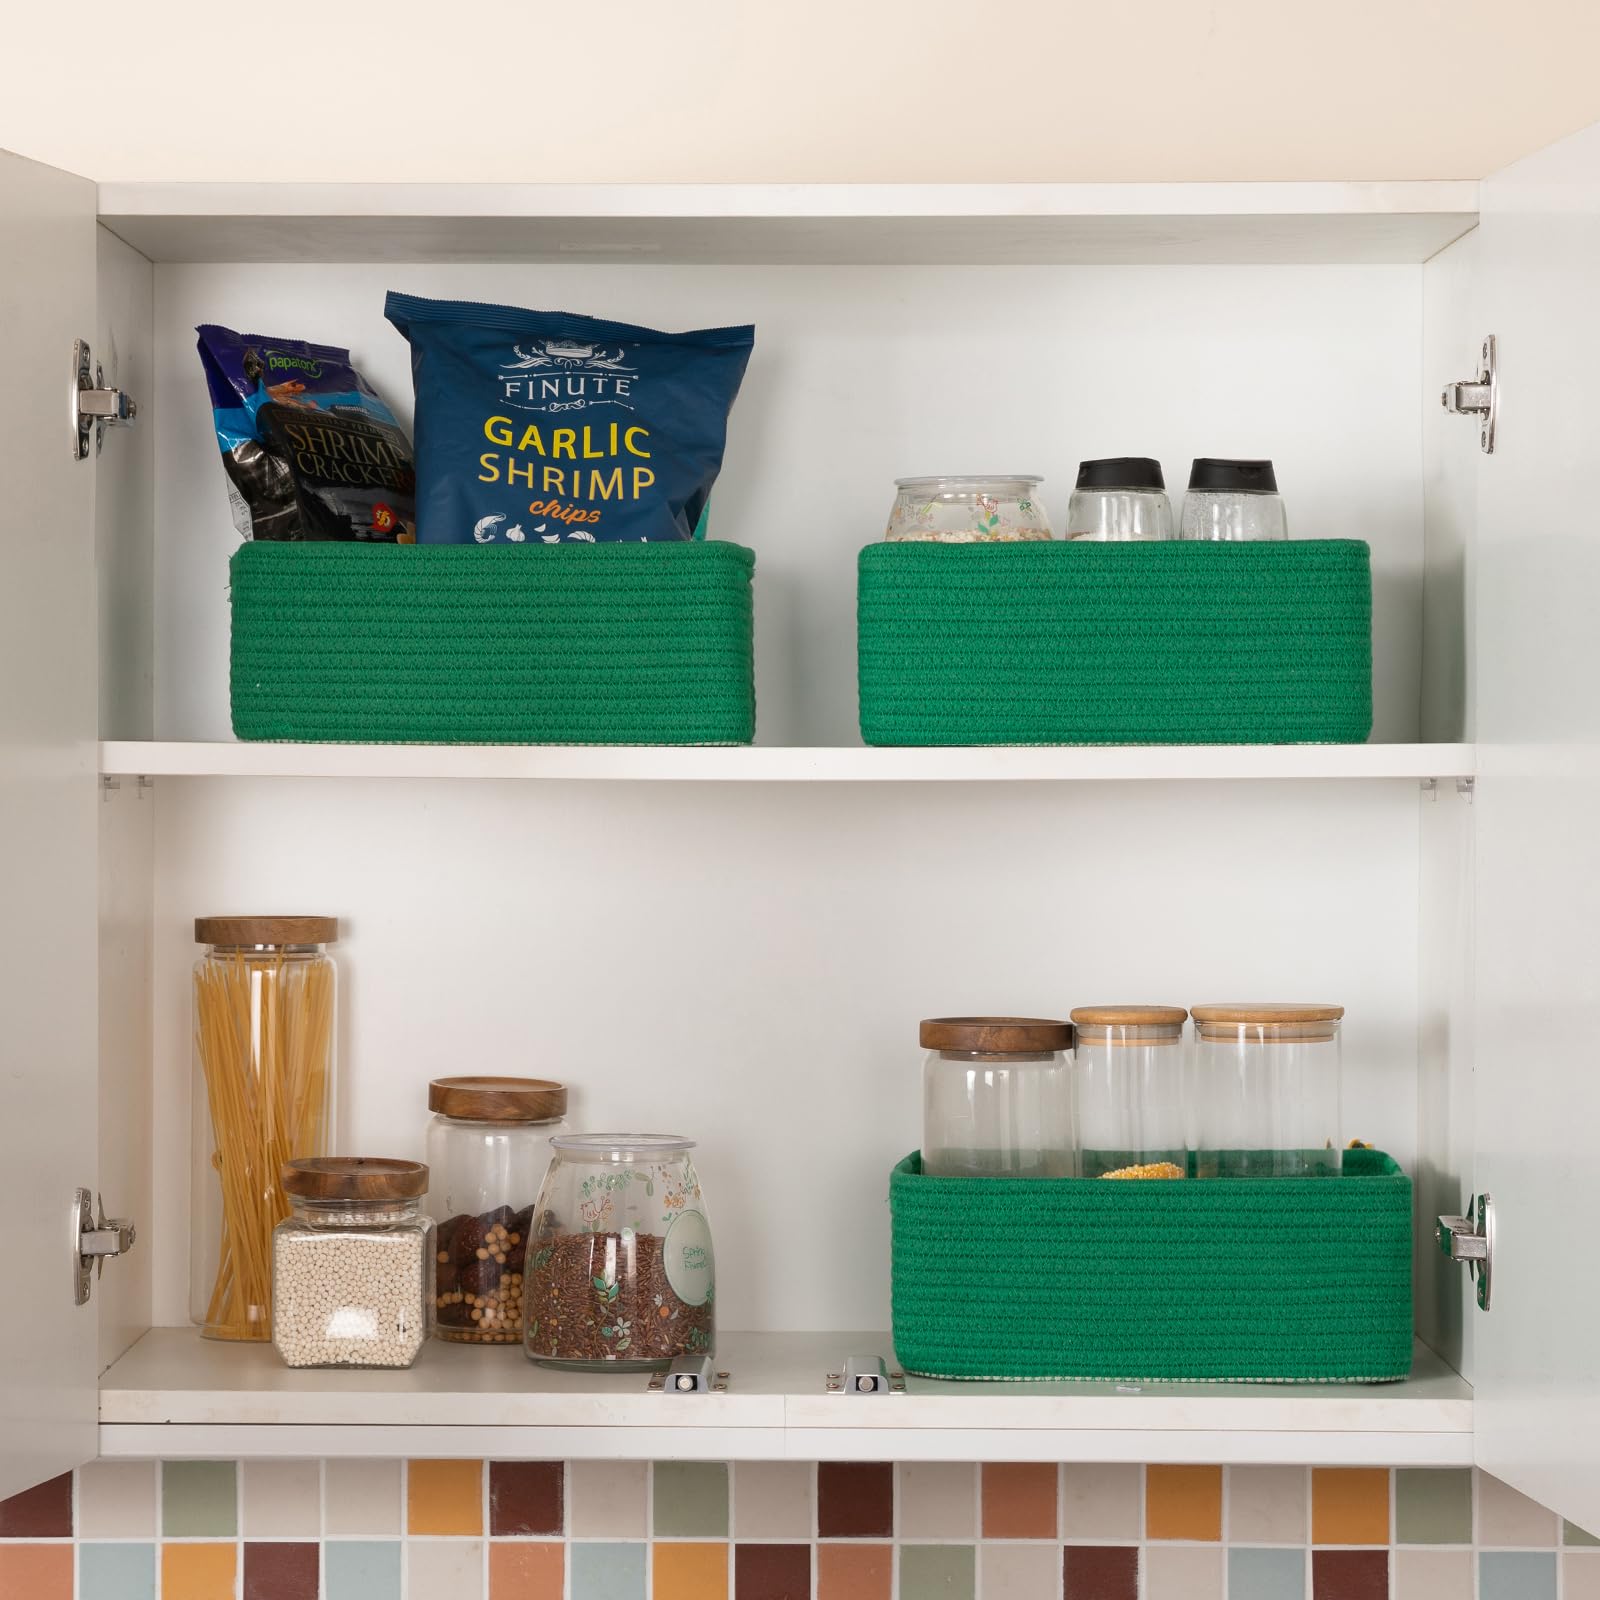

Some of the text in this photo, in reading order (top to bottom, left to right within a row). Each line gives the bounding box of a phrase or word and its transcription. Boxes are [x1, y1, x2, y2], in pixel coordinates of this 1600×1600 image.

[505, 377, 631, 400] FINUTE
[285, 423, 406, 468] SHRIMP
[484, 415, 651, 459] GARLIC
[478, 453, 656, 501] SHRIMP
[529, 499, 602, 525] chips
